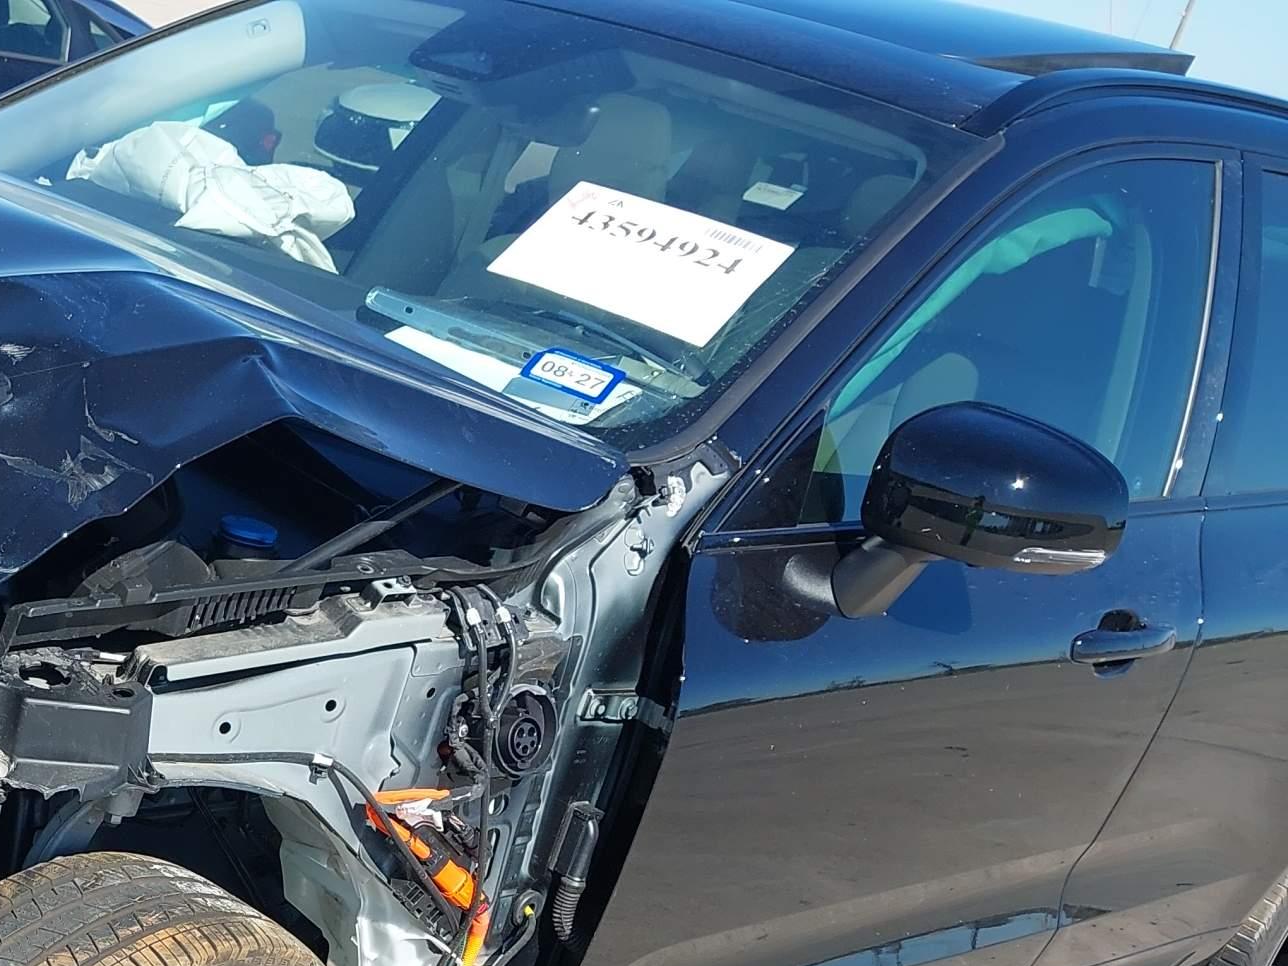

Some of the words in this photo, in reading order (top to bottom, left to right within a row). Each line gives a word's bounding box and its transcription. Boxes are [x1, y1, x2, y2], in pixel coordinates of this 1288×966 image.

[571, 210, 743, 274] 43594924
[540, 360, 568, 377] 08
[575, 373, 606, 390] 27
